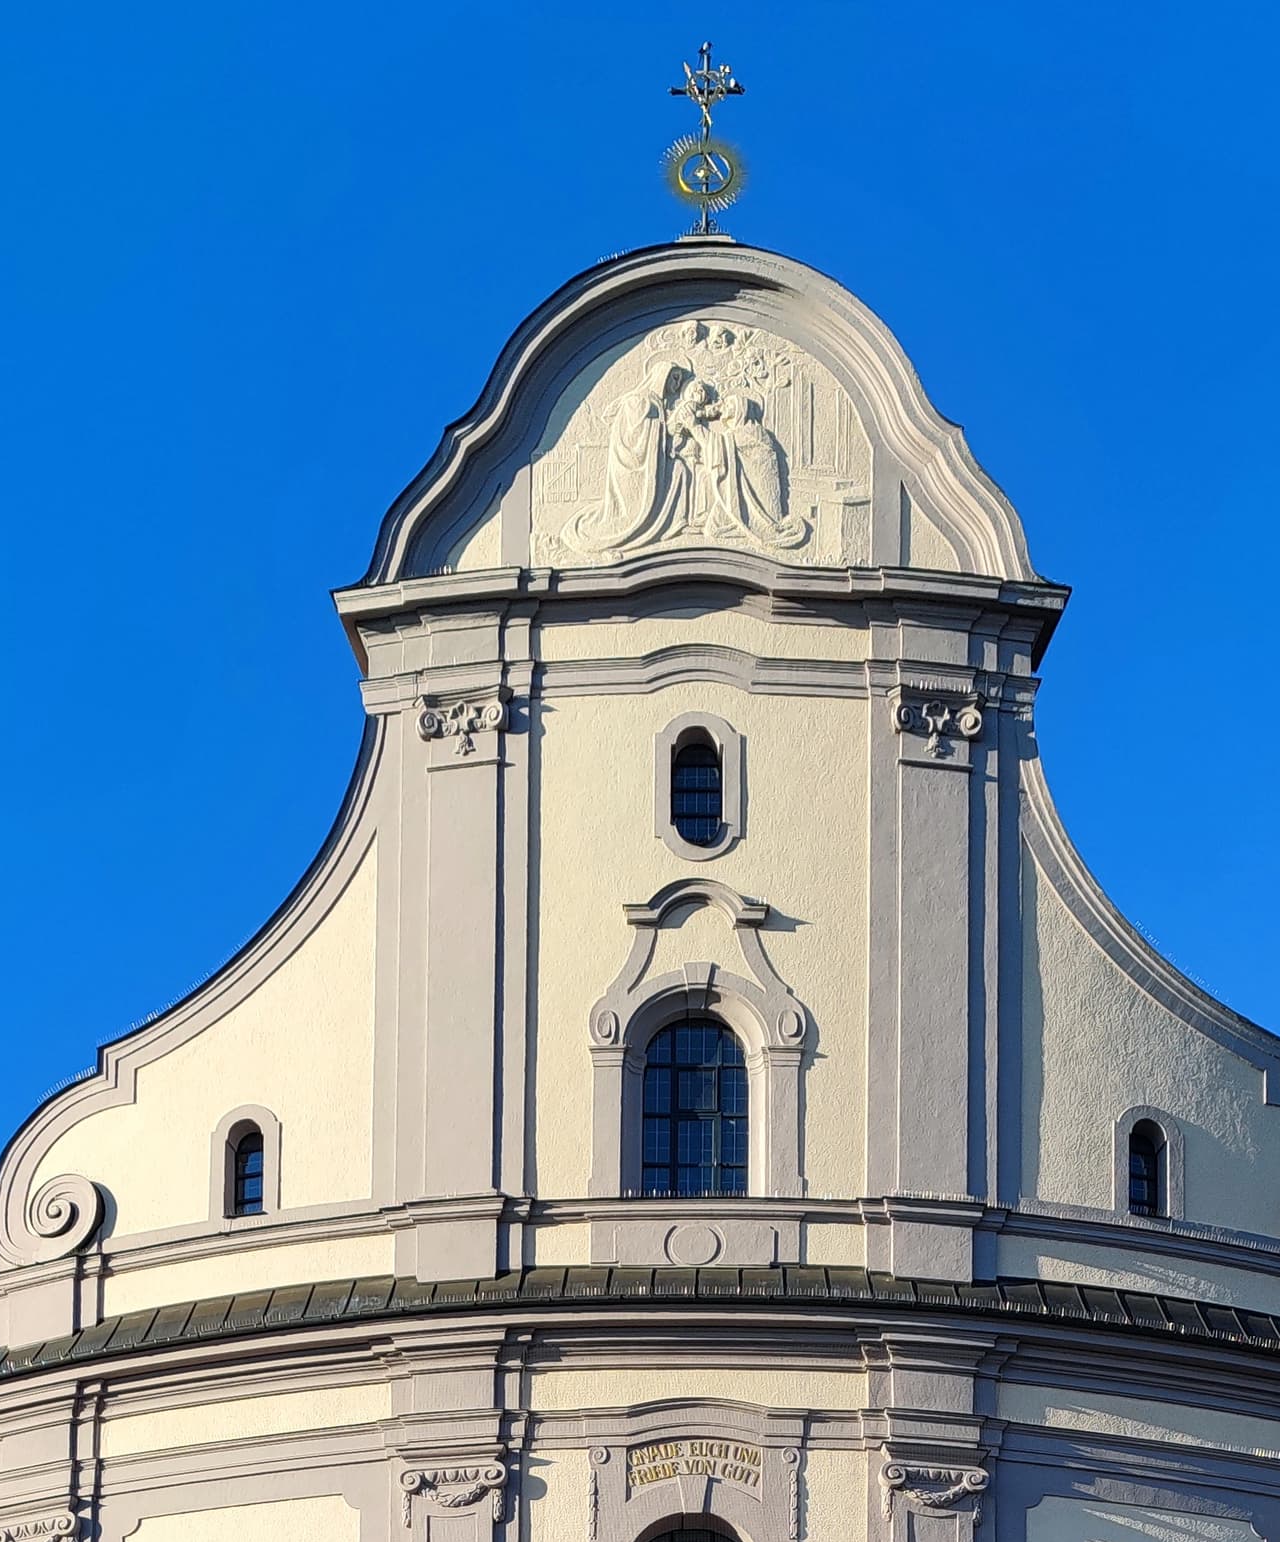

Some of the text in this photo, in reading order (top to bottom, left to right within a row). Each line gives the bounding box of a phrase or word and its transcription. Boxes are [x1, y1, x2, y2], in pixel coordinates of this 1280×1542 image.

[628, 1441, 761, 1467] GNADE EUCH UND
[628, 1459, 761, 1487] FRIEDE VON GOTT
